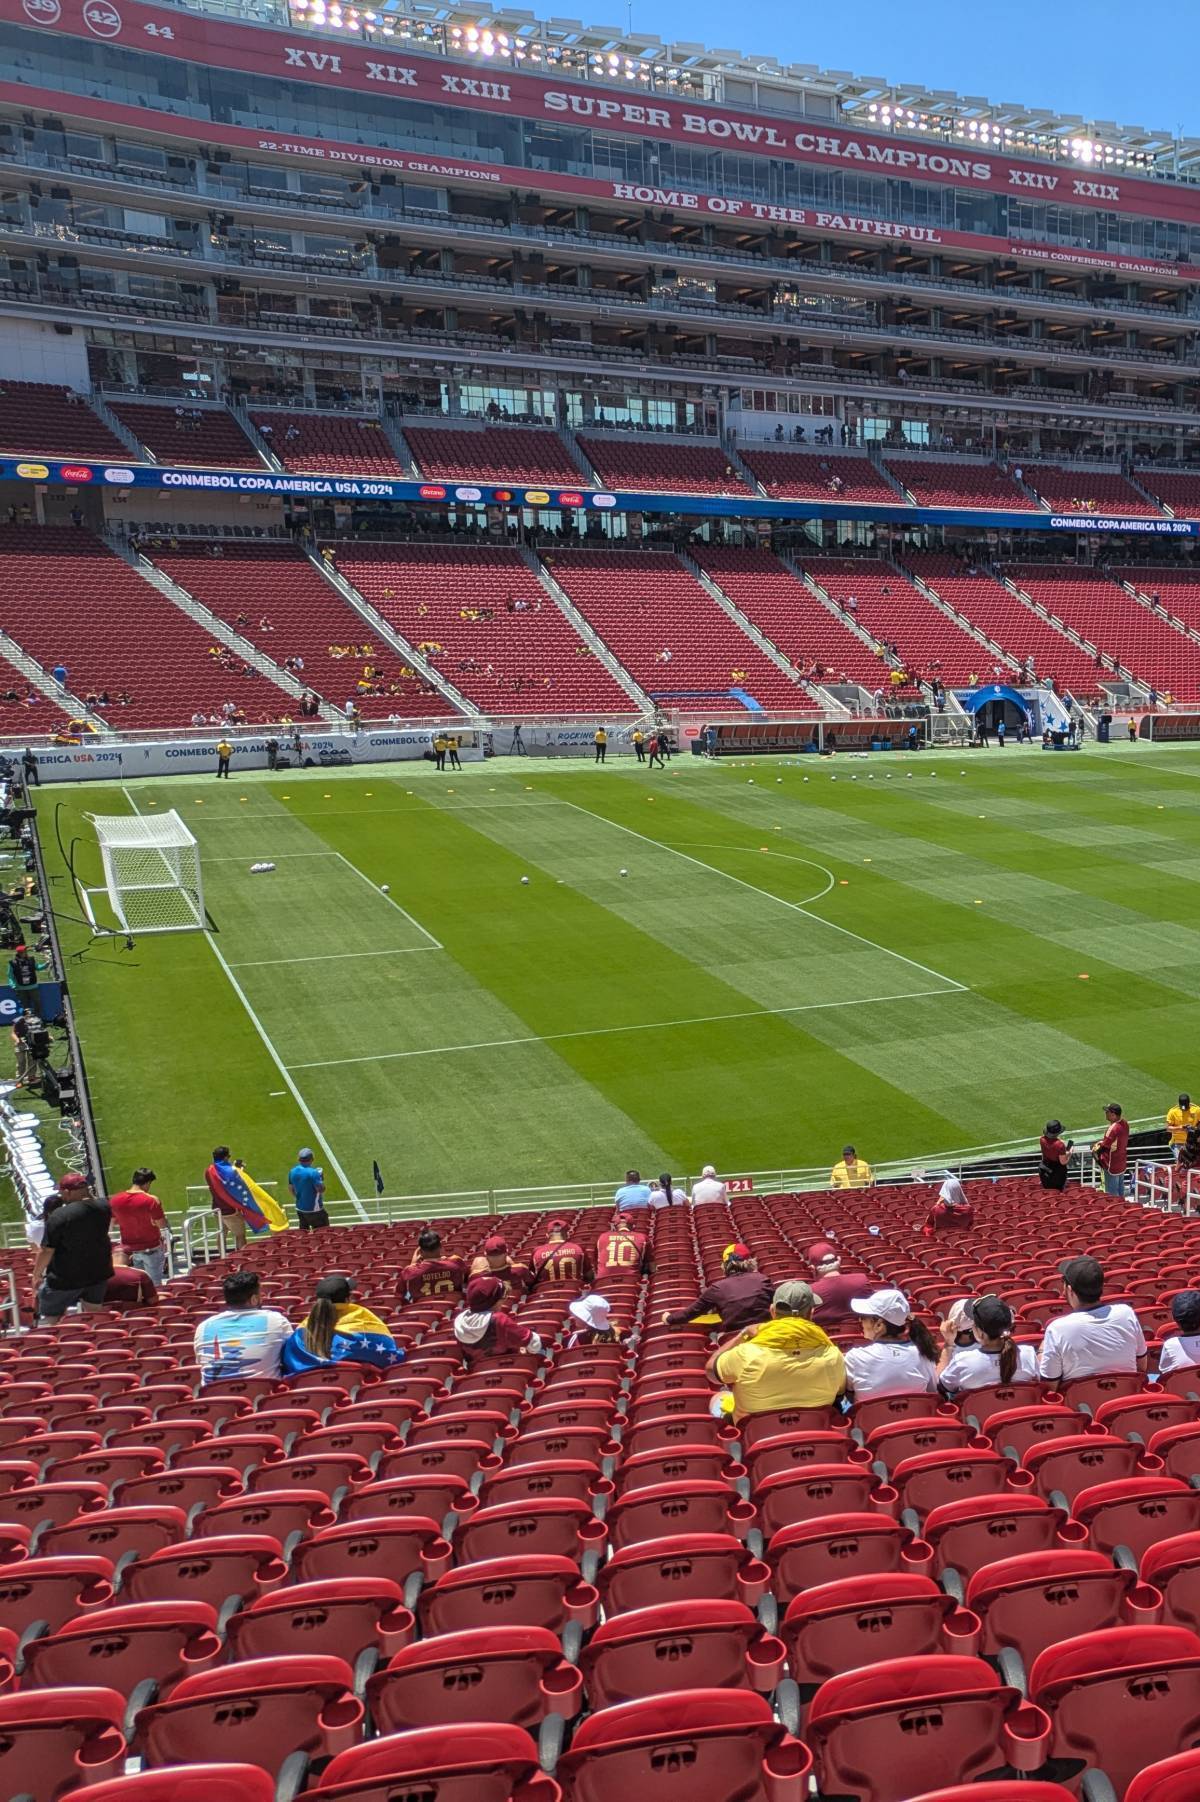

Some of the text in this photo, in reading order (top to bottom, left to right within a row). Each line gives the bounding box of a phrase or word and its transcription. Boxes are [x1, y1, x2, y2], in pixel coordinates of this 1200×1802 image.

[88, 10, 118, 27] 42
[143, 23, 175, 40] 44
[284, 47, 512, 101] XVI XIX XXIII
[543, 91, 1120, 201] SUPER BOWL CHAMPIONS XXIV XXIX
[258, 140, 501, 182] 22-TIME DIVISION CHAMPIONS
[612, 183, 942, 243] HOME OF THE FAITHFUL
[1050, 252, 1117, 268] CONFERENCE
[1119, 262, 1179, 276] CHAMPIONS
[162, 473, 393, 495] CONMEBOL COPA AMERICA USA 2024
[1050, 517, 1097, 529] CONMEBOL
[1097, 519, 1119, 529] COPA
[1119, 520, 1155, 531] AMERICA
[1156, 522, 1172, 532] USA
[1172, 523, 1192, 533] 2024
[370, 736, 417, 746] CONMEBOL
[73, 753, 95, 763] USA
[725, 1179, 751, 1193] 121
[605, 1241, 638, 1267] 10
[543, 1258, 577, 1281] 10
